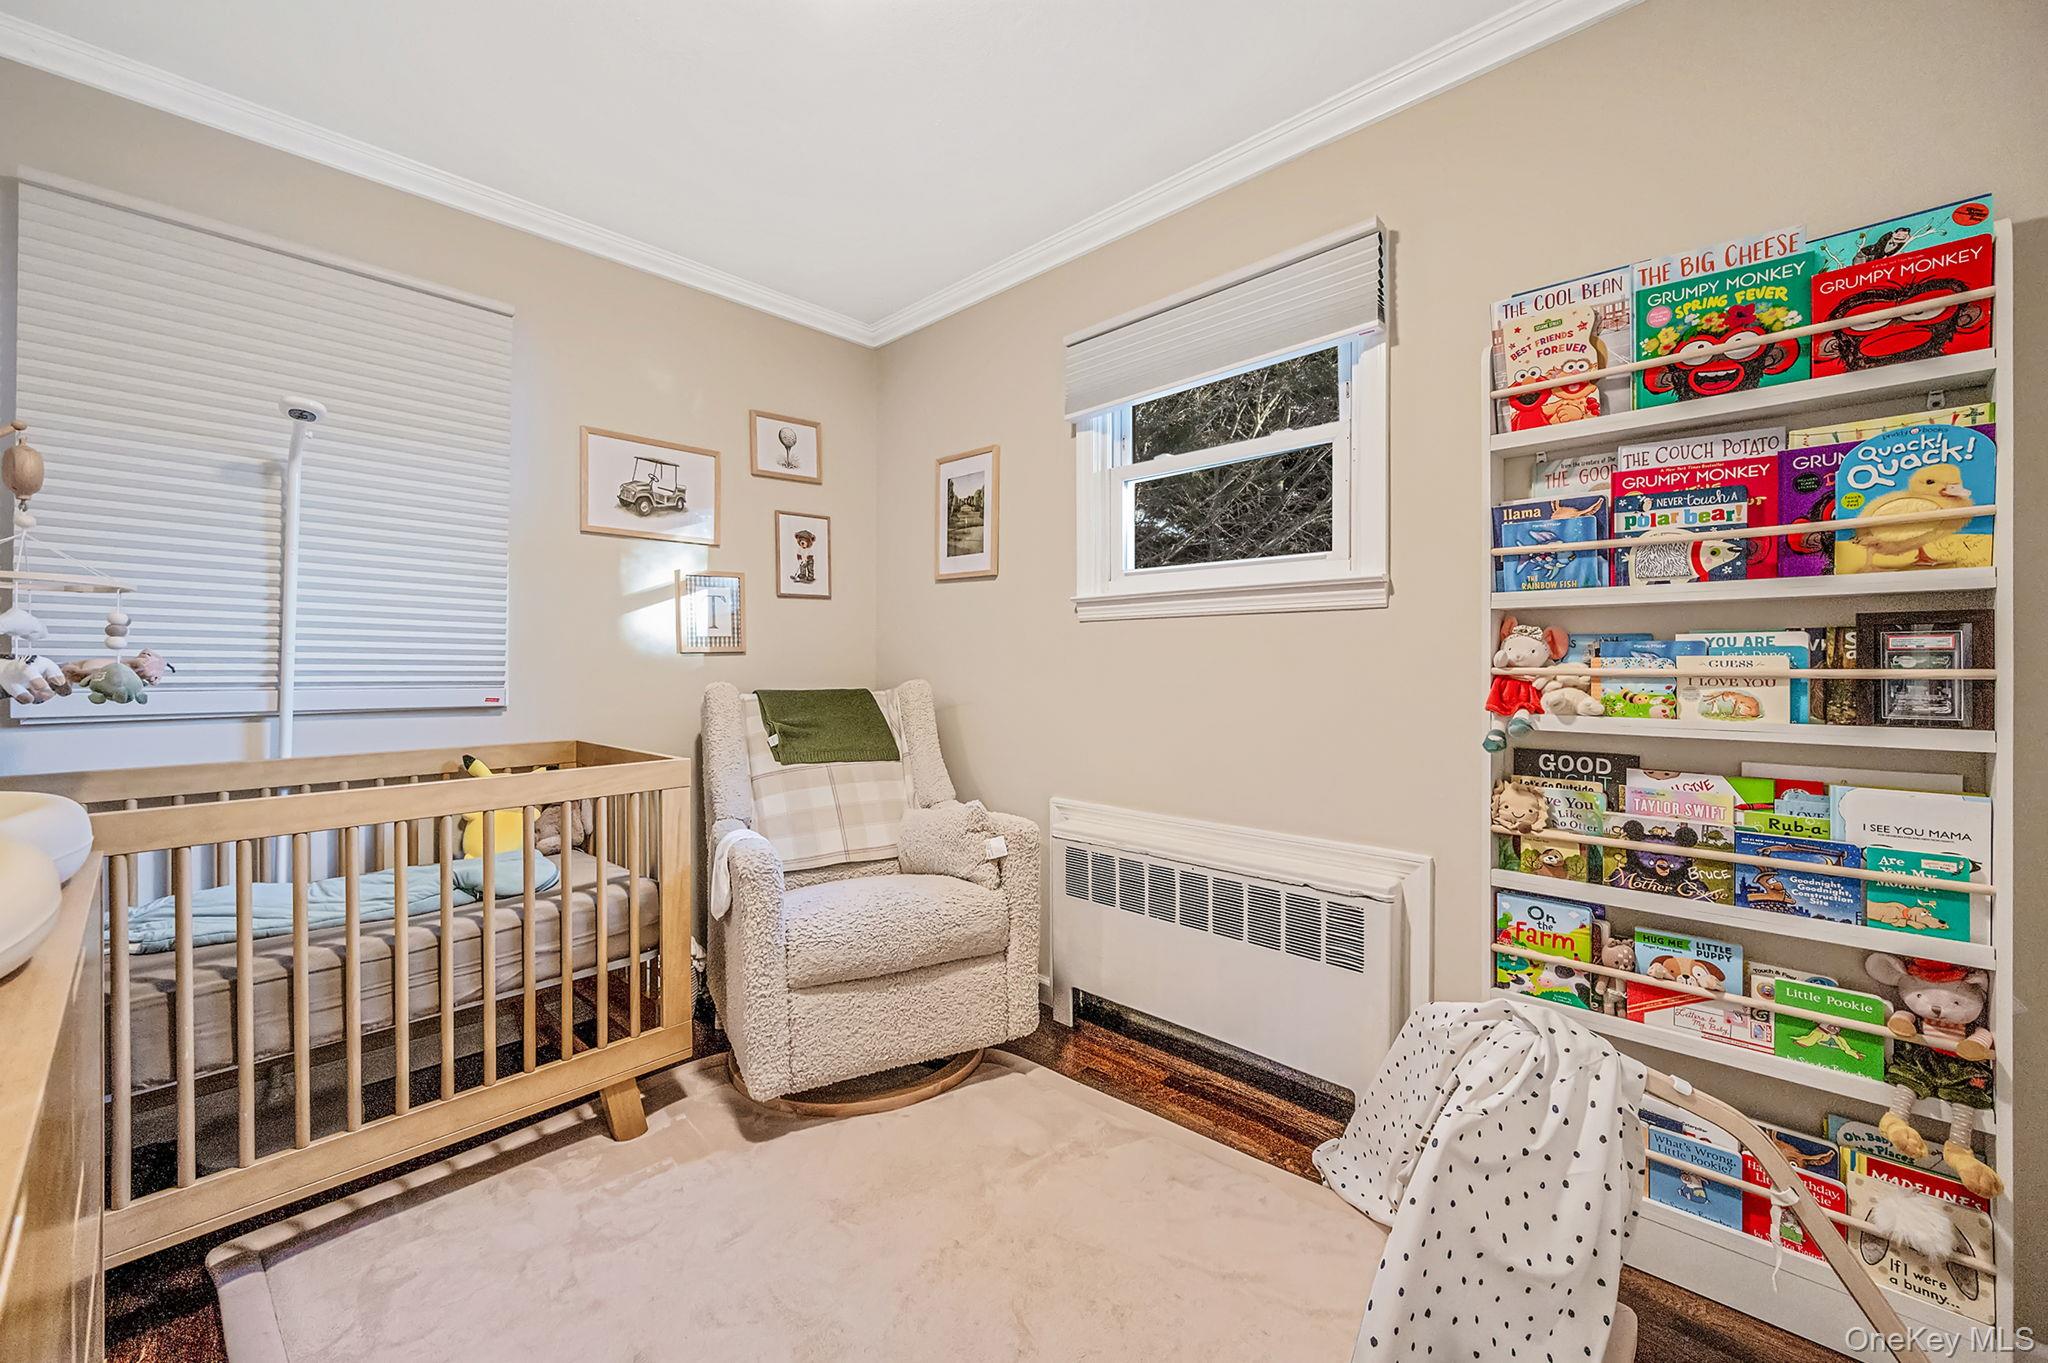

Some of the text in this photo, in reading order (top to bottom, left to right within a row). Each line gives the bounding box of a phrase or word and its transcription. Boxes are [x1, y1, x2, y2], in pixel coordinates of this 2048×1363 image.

[1638, 232, 1799, 286] THE BIG CHEESE
[1819, 266, 1895, 295] GRUMPY
[1900, 246, 1983, 277] MONKEY
[1648, 261, 1806, 307] GRUMPY MONKEY
[1503, 276, 1623, 319] THE COOL BEAN
[1674, 294, 1728, 319] SPRING
[1735, 285, 1789, 305] FEVER
[1510, 330, 1574, 361] BEST FRIENDS
[1537, 343, 1587, 358] FOREVER
[1623, 435, 1780, 469] THE COUCH POTATO
[1857, 432, 1943, 463] Quack!
[1847, 437, 1976, 489] Quack!
[1545, 470, 1570, 489] THE
[1622, 471, 1690, 490] GRUMPY
[1696, 463, 1771, 482] MONKEY
[1656, 496, 1684, 507] NEVER
[1684, 489, 1730, 506] touch
[1731, 491, 1738, 501] A
[1503, 508, 1541, 521] llama
[1625, 503, 1743, 530] polar bear!
[1521, 579, 1578, 590] RAINBOW FISH
[705, 594, 727, 630] T
[1705, 635, 1776, 647] YOU ARE
[1708, 660, 1754, 668] GUESS
[1700, 677, 1739, 687] LOVE
[1744, 678, 1777, 688] YOU
[1538, 753, 1612, 775] GOOD
[1565, 797, 1594, 811] You
[1634, 798, 1727, 820] TAYLOR SWIFT
[1558, 810, 1582, 820] Like
[1569, 820, 1598, 833] Otter
[1769, 818, 1829, 835] Rub-a-
[1870, 824, 1890, 834] SEE
[1894, 826, 1925, 837] YOU
[1929, 829, 1973, 841] MAMA
[1878, 855, 1905, 867] Are
[1603, 867, 1673, 893] Mother
[1789, 875, 1844, 890] Goodnight,
[1791, 888, 1854, 904] Construction
[1797, 883, 1852, 898] Goodnight,
[1809, 898, 1829, 907] Site
[1527, 905, 1557, 924] On
[1537, 921, 1554, 931] the
[1515, 921, 1575, 951] Farm
[1643, 934, 1684, 948] HUG ME
[1696, 941, 1732, 955] LITTLE
[1696, 950, 1733, 963] PUPPY
[1753, 967, 1774, 975] Touch
[1786, 987, 1873, 1014] Little Pookie
[1654, 1133, 1737, 1167] What's Wrong,
[1658, 1144, 1686, 1160] Little
[1691, 1155, 1733, 1175] Pookie?
[1890, 1258, 1902, 1274] If
[1913, 1270, 1948, 1290] were
[1890, 1276, 1961, 1309] a bunny...
